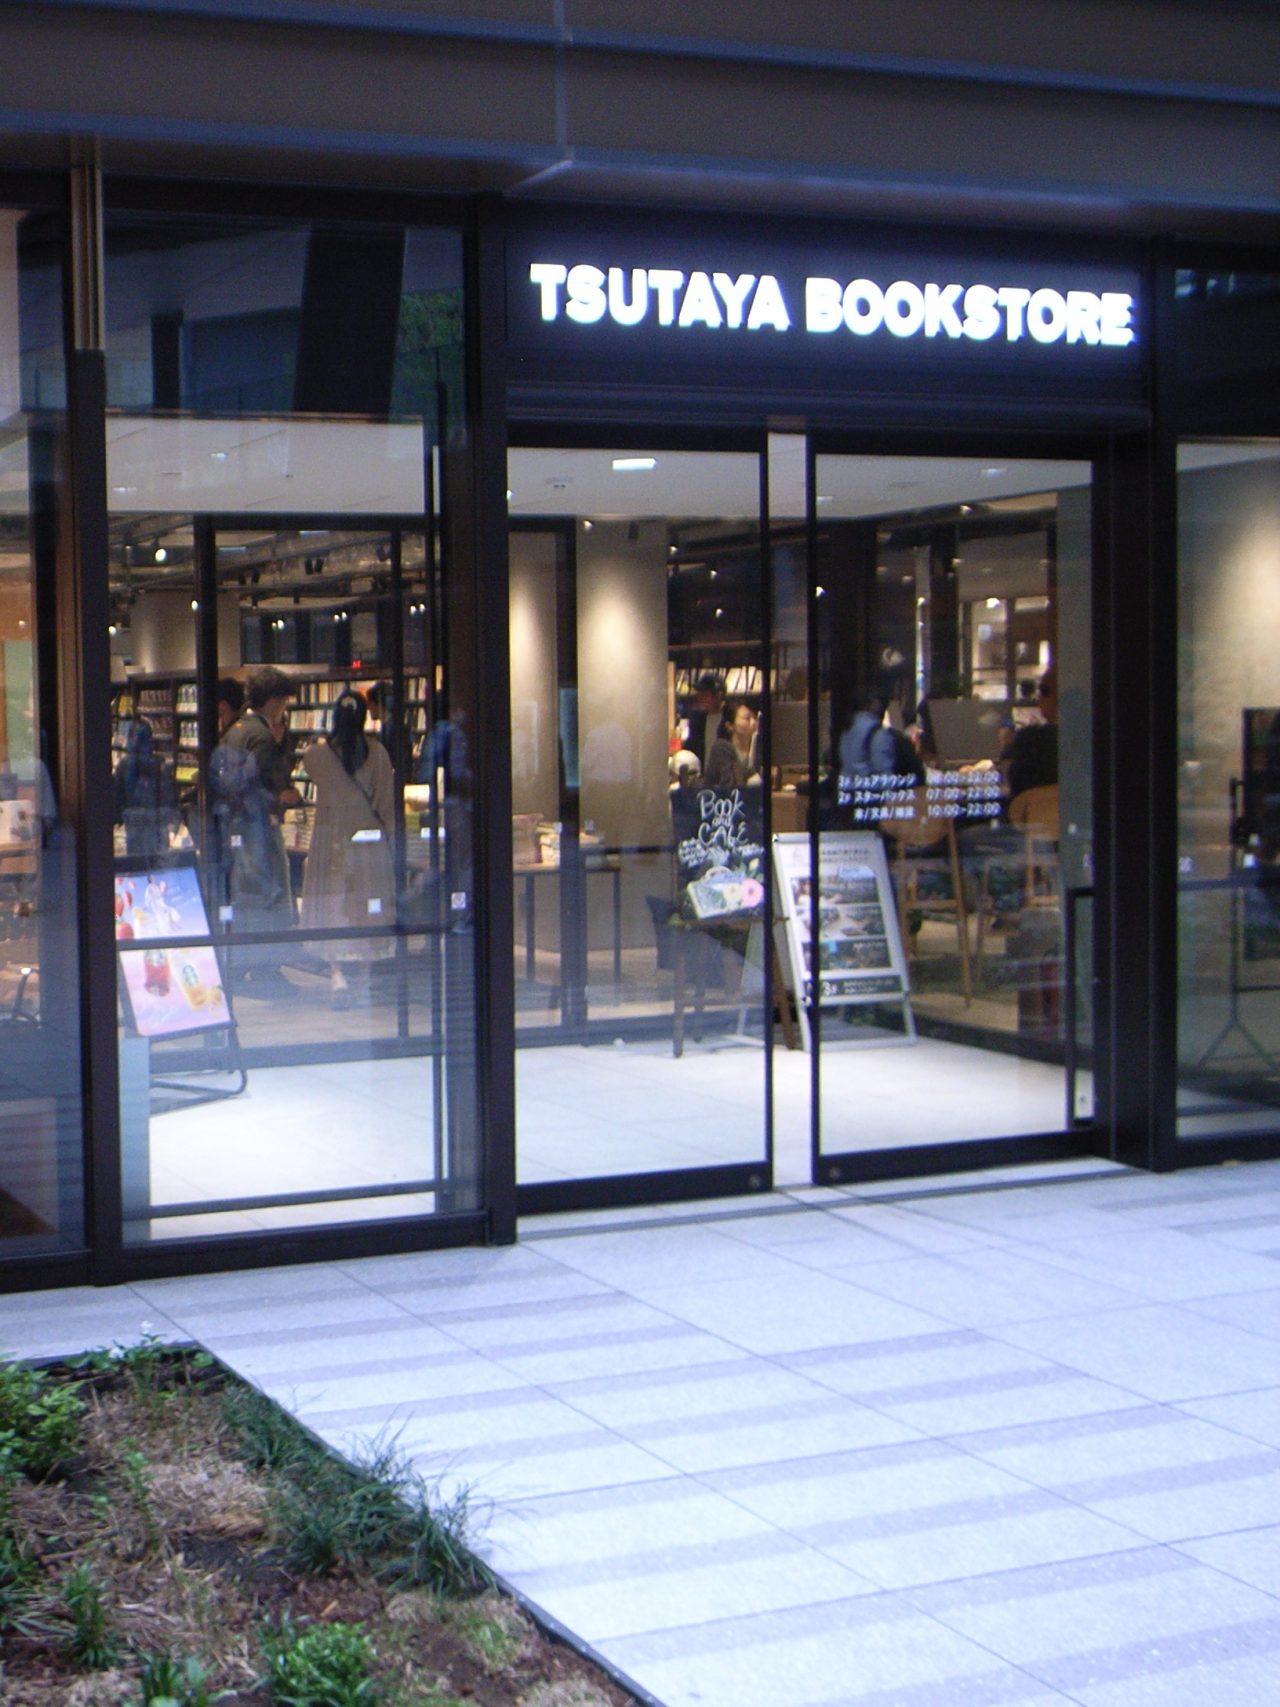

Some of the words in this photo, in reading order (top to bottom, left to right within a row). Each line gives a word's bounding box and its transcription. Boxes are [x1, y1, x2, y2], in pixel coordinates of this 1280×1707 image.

[530, 263, 791, 331] TSUTAYA
[804, 276, 1136, 345] BOOKSTORE
[854, 789, 916, 803] スターバックス
